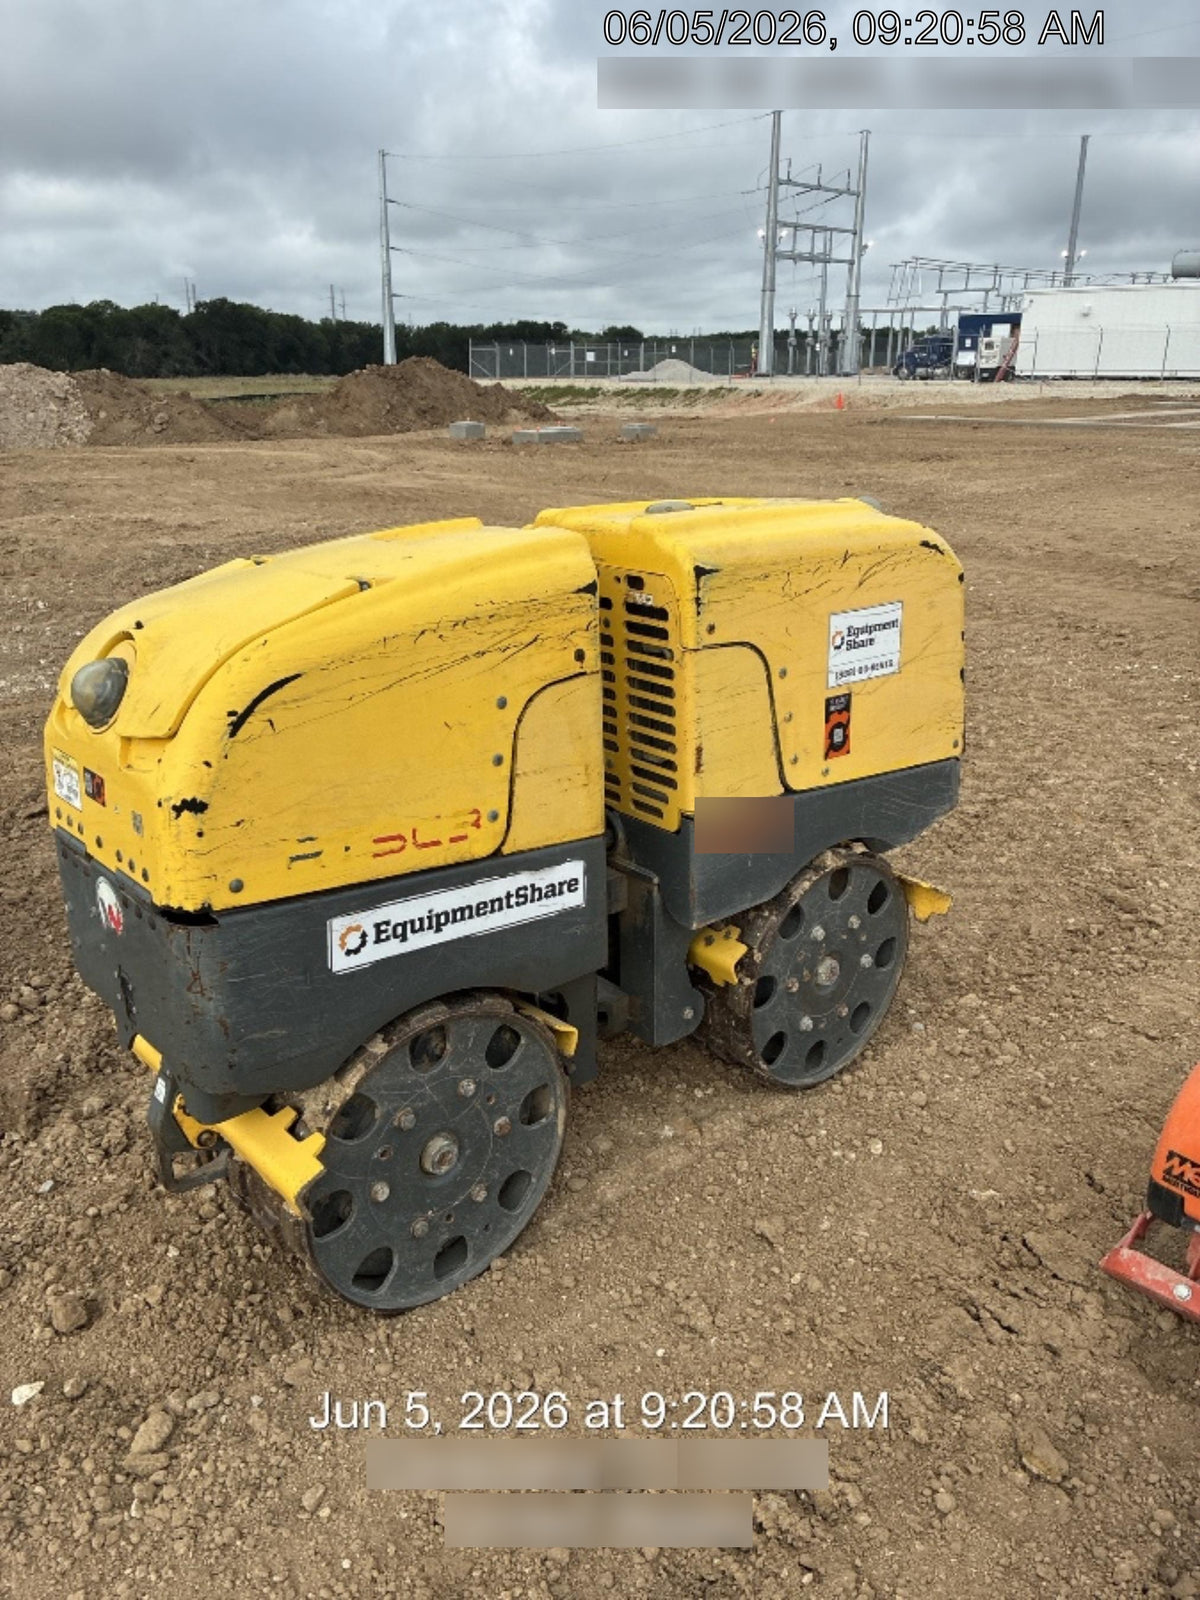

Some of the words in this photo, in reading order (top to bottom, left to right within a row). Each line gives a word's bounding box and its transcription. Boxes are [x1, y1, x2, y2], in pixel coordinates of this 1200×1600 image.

[846, 618, 899, 638] Equipment
[845, 638, 875, 652] Share
[373, 877, 580, 944] EquipmentShare
